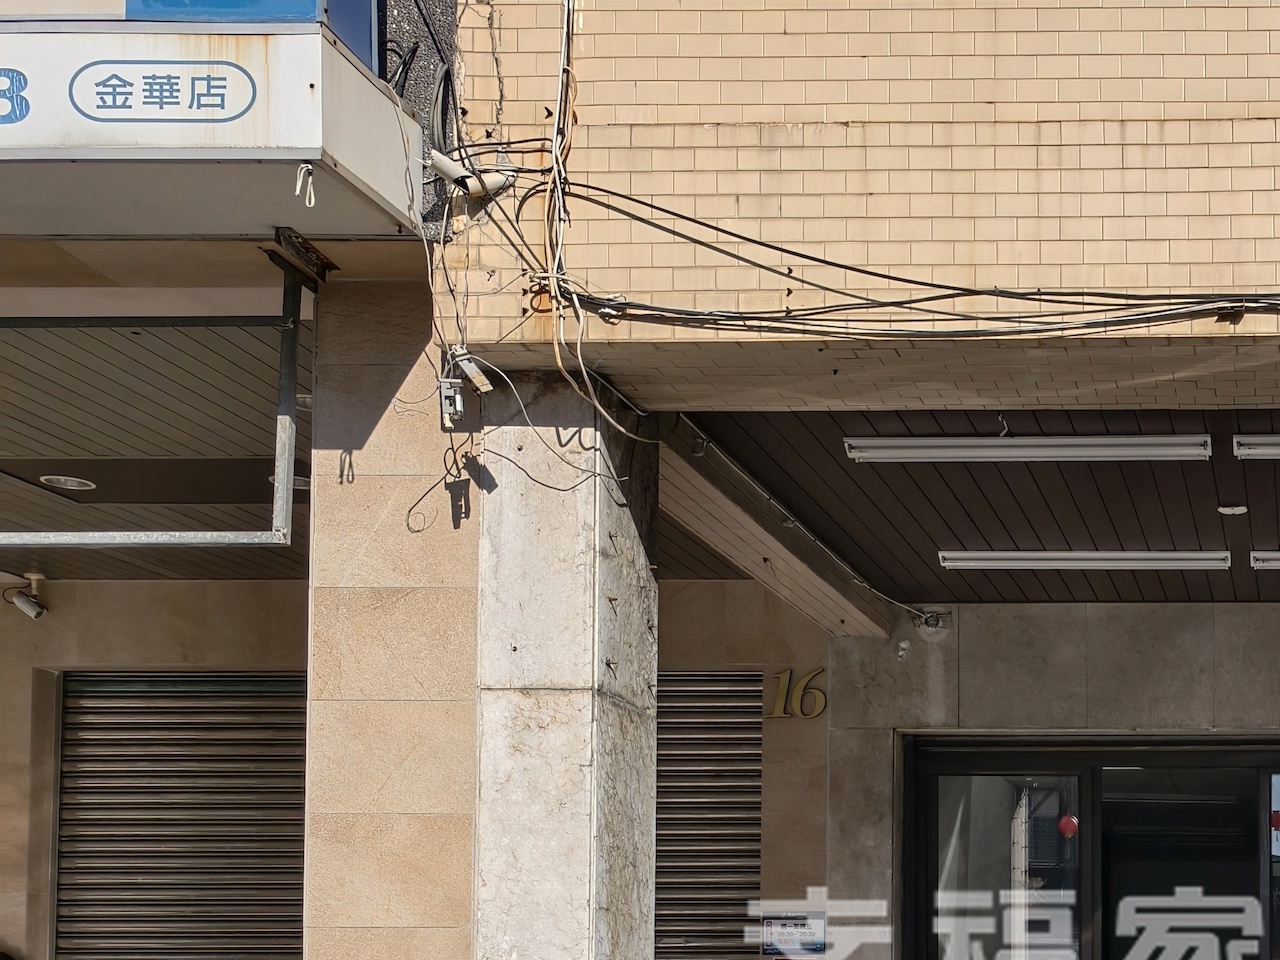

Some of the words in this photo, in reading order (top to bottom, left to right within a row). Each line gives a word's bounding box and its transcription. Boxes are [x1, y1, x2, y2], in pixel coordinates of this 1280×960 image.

[94, 73, 227, 110] 金華店
[764, 667, 827, 719] 16
